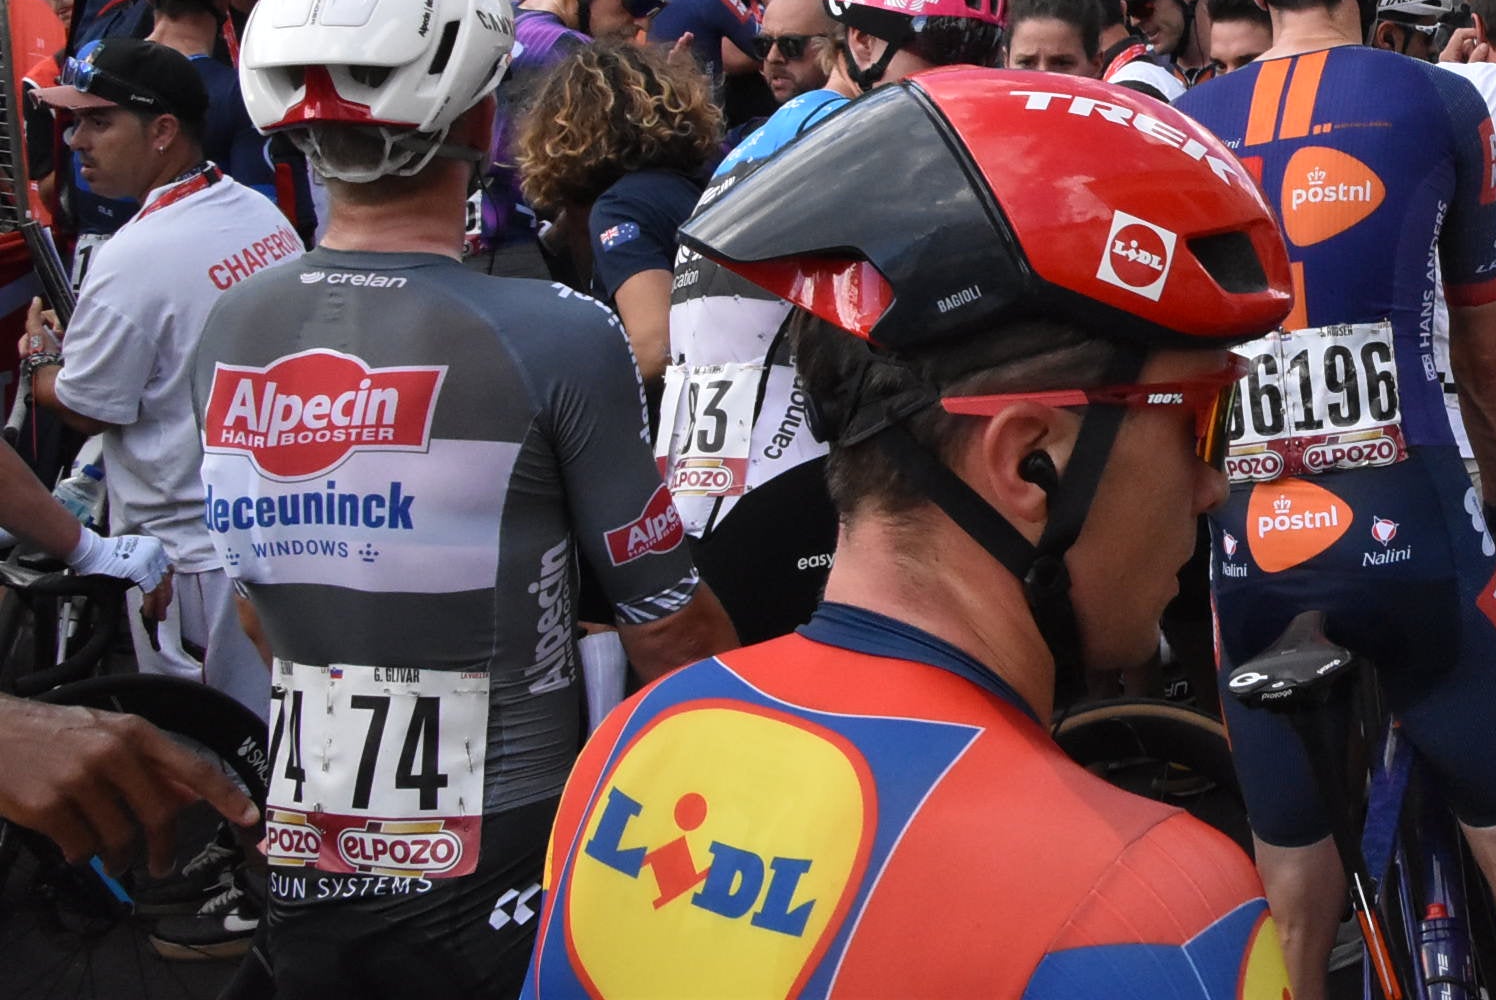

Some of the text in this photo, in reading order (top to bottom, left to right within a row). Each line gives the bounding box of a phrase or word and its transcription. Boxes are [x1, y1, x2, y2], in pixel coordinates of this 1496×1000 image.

[418, 10, 432, 38] Alpecin
[1010, 90, 1238, 185] TREK
[1292, 180, 1371, 211] postnl
[208, 224, 301, 291] CHAPERÓN
[326, 271, 407, 289] crelan
[1418, 200, 1448, 348] HANS ANDERS
[937, 285, 983, 313] BAGIOLI
[1147, 393, 1183, 404] 100%
[1289, 341, 1398, 431] 196
[224, 377, 399, 448] Alpecin
[221, 427, 394, 450] HAIR BOOSTER
[205, 480, 415, 535] deceuninck
[1258, 505, 1338, 539] postnl
[252, 539, 349, 559] WINDOWS
[1361, 544, 1412, 567] Nalini
[1222, 562, 1248, 578] Nalini
[524, 537, 572, 696] Alpecin
[374, 667, 420, 684] G. GLIVAR
[1262, 689, 1293, 701] prologo
[350, 694, 448, 811] 74
[271, 871, 434, 899] SUN SYSTEMS
